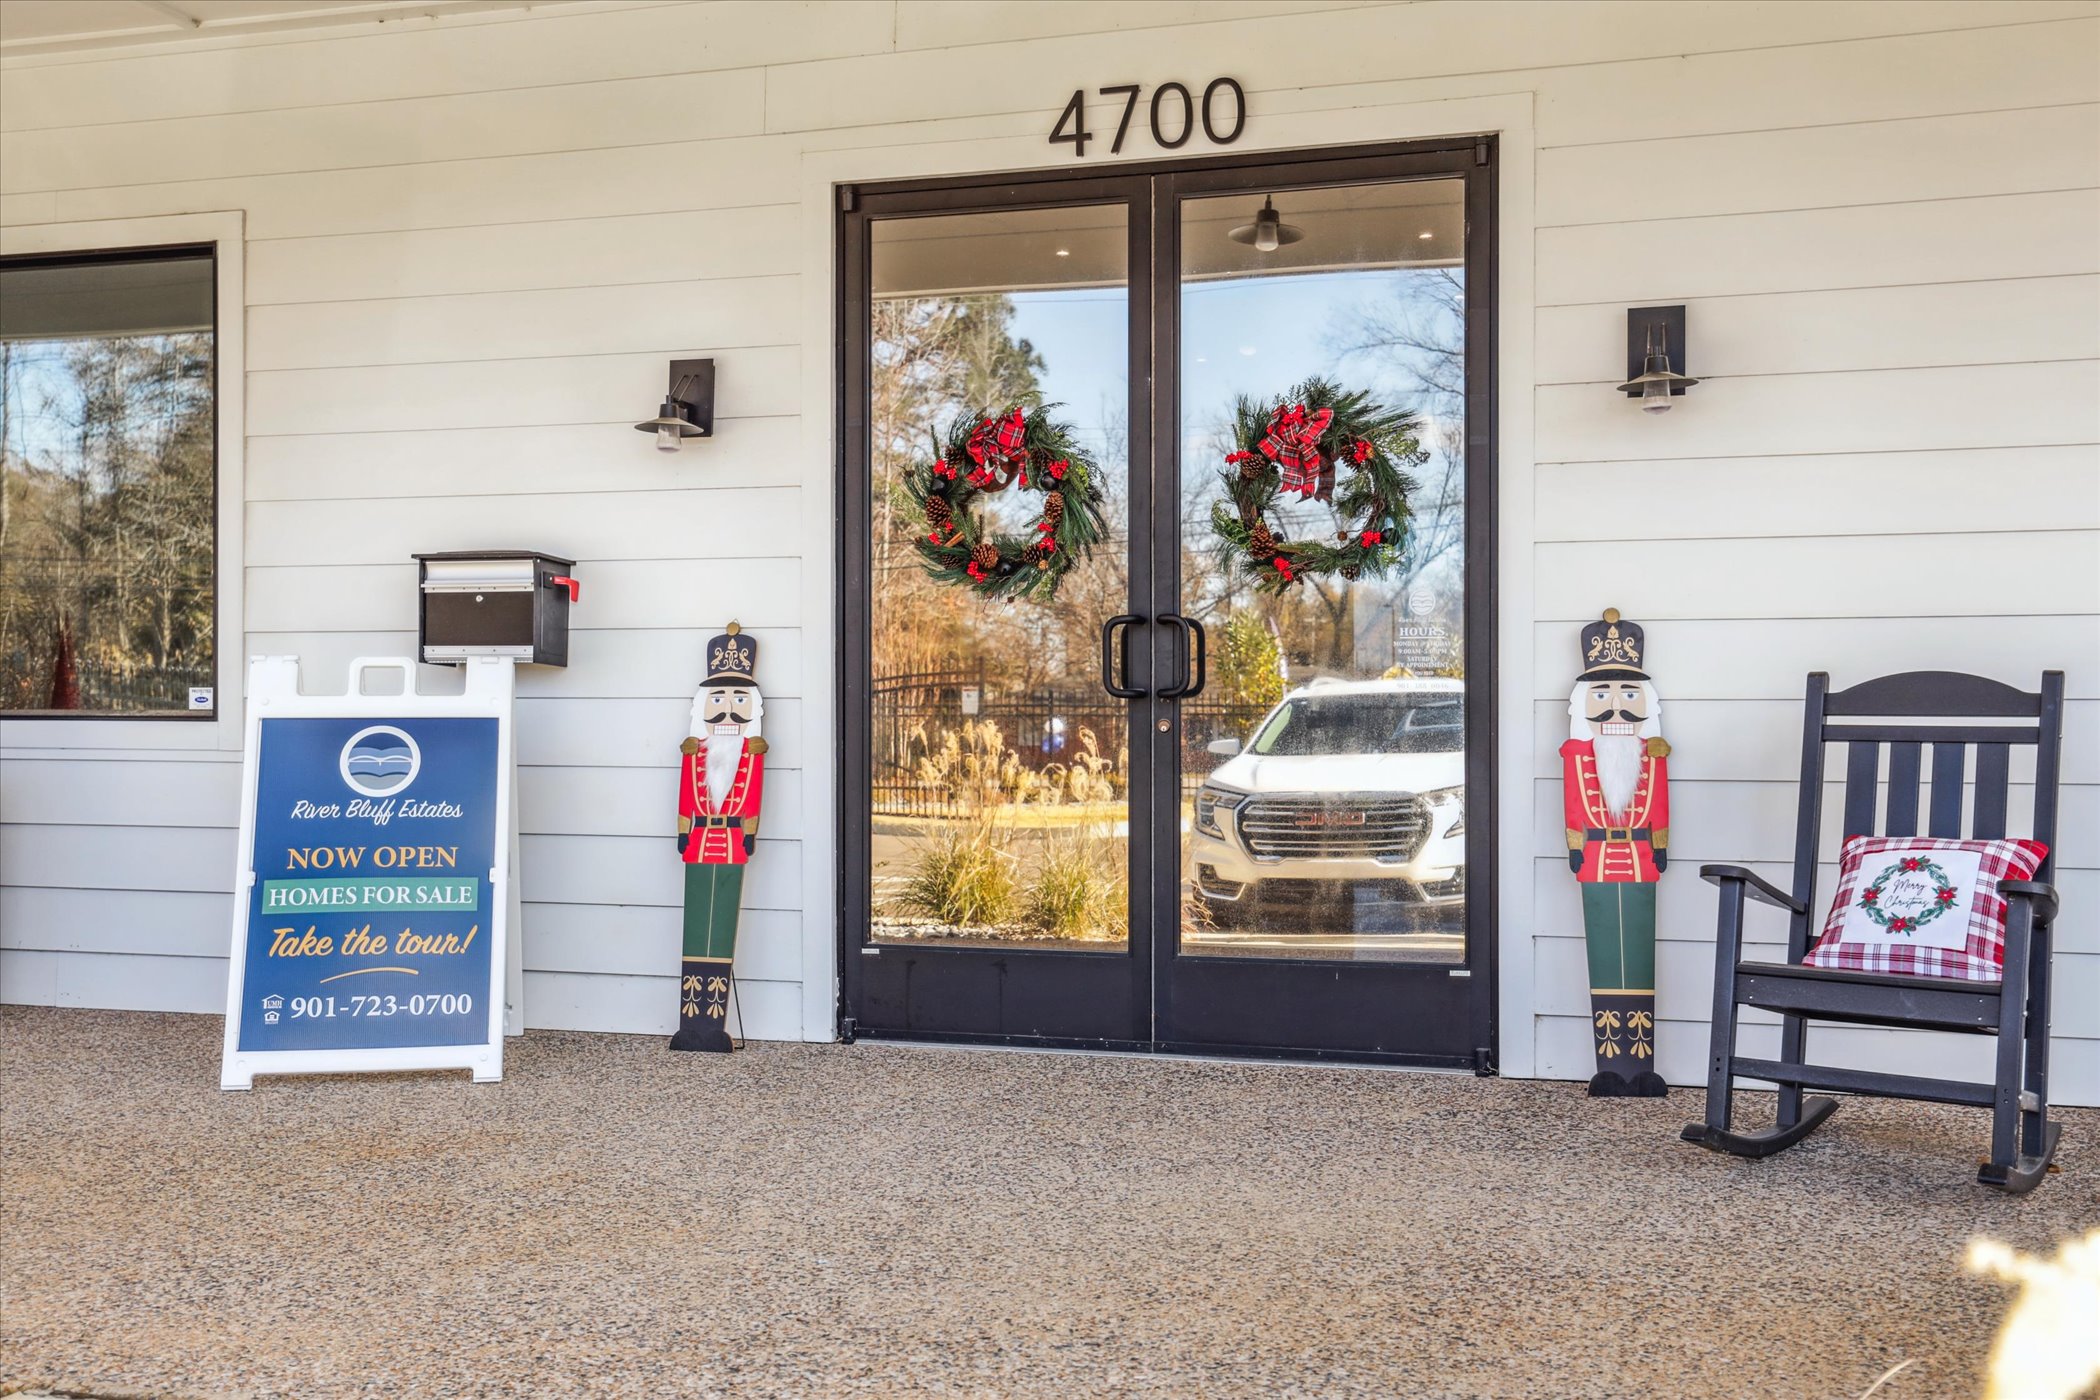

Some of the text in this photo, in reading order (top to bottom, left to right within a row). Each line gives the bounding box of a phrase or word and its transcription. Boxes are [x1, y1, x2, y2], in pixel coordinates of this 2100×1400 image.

[1048, 77, 1246, 157] 4700
[290, 798, 463, 826] River Bluff Estates
[286, 846, 459, 870] NOW OPEN
[268, 885, 473, 907] HOMES FOR SALE
[1892, 878, 1927, 896] Merry
[1883, 895, 1930, 910] Christmas
[268, 924, 478, 957] Take the tour!
[290, 993, 473, 1019] 901-723-0700
